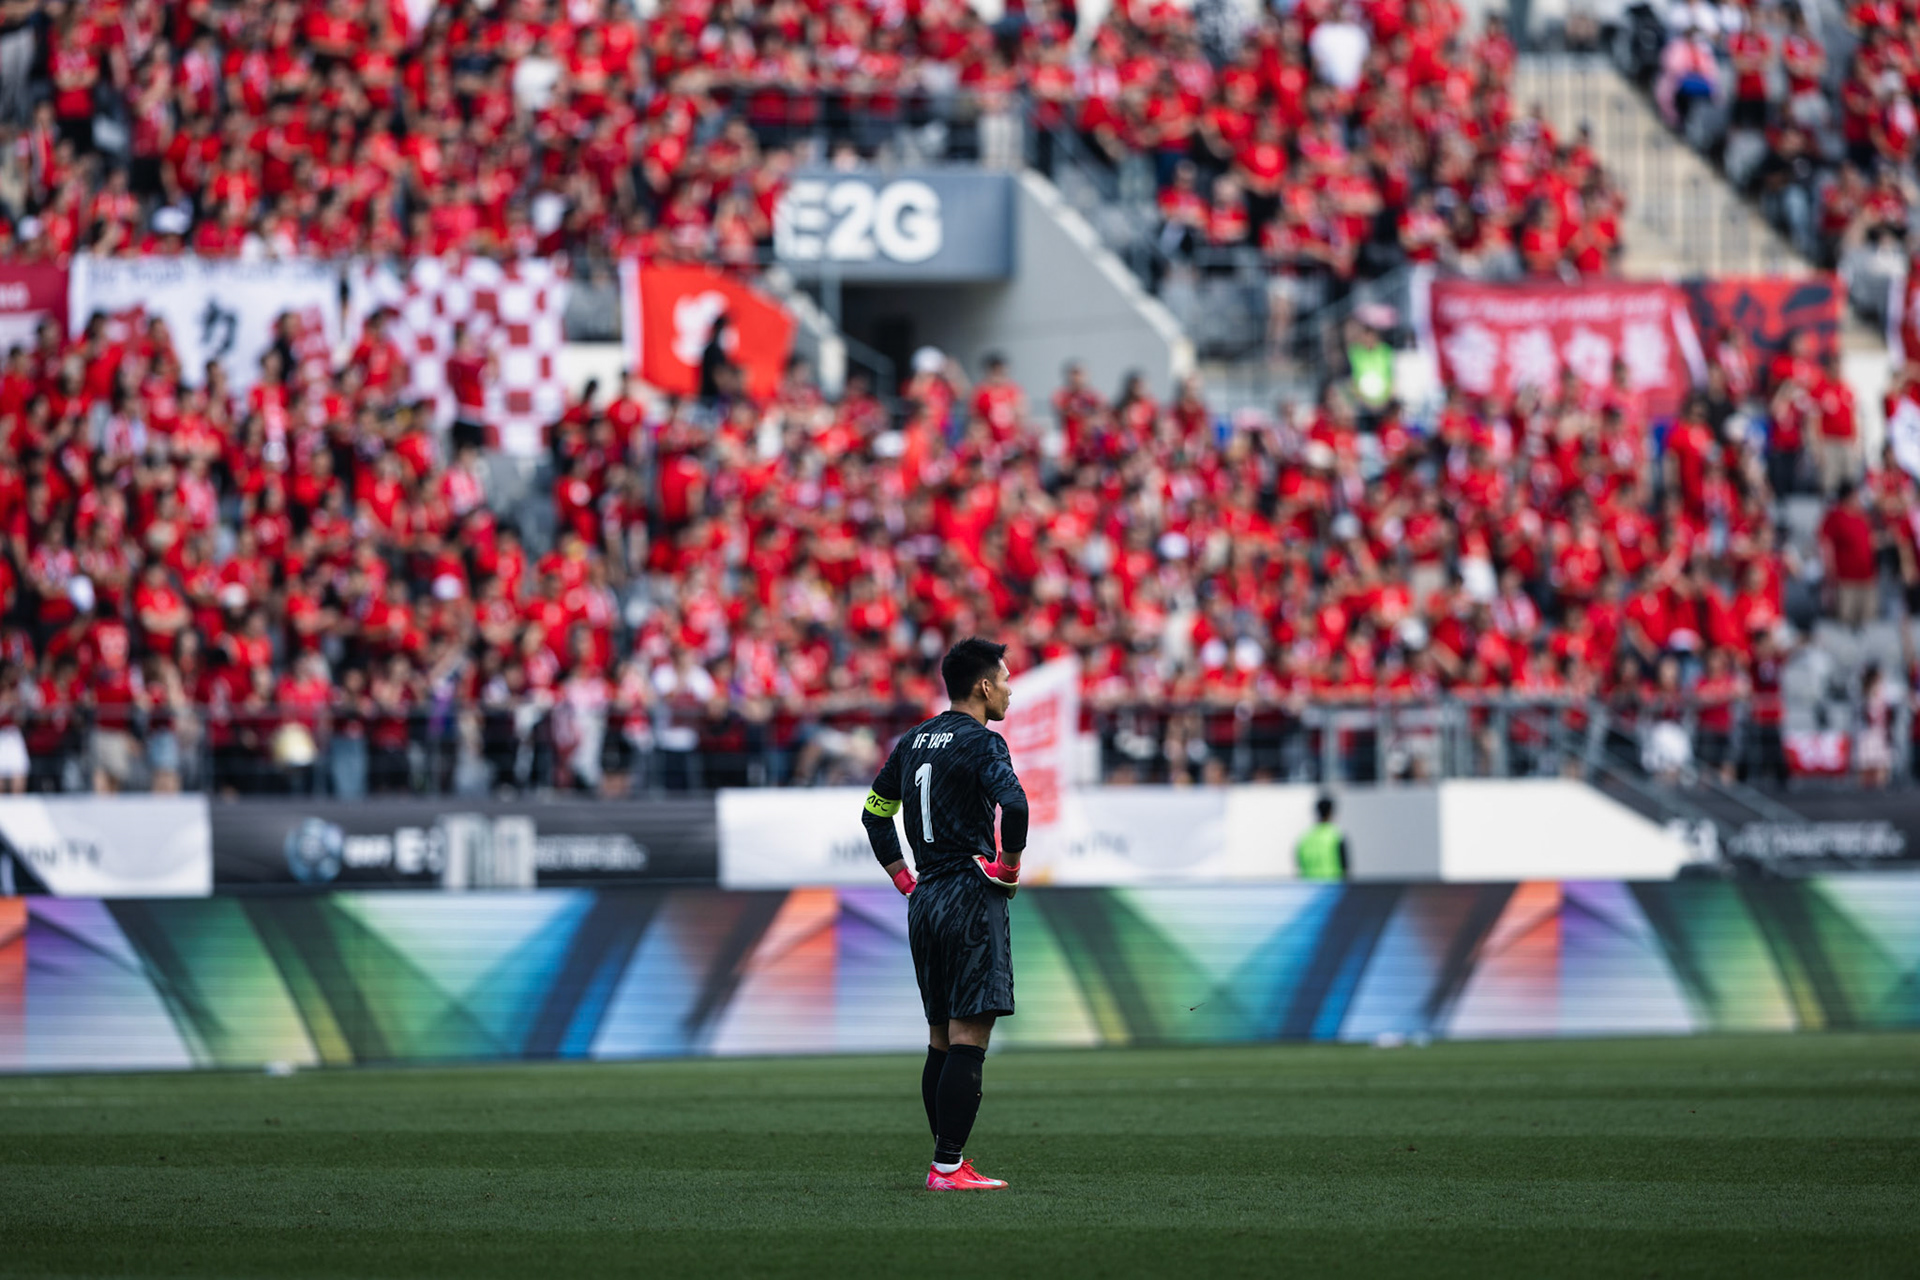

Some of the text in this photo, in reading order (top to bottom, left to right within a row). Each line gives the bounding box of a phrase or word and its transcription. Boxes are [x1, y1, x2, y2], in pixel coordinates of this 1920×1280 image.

[773, 180, 943, 263] E2G
[927, 732, 954, 749] YAPP
[867, 795, 892, 812] AFC
[914, 762, 935, 843] 1
